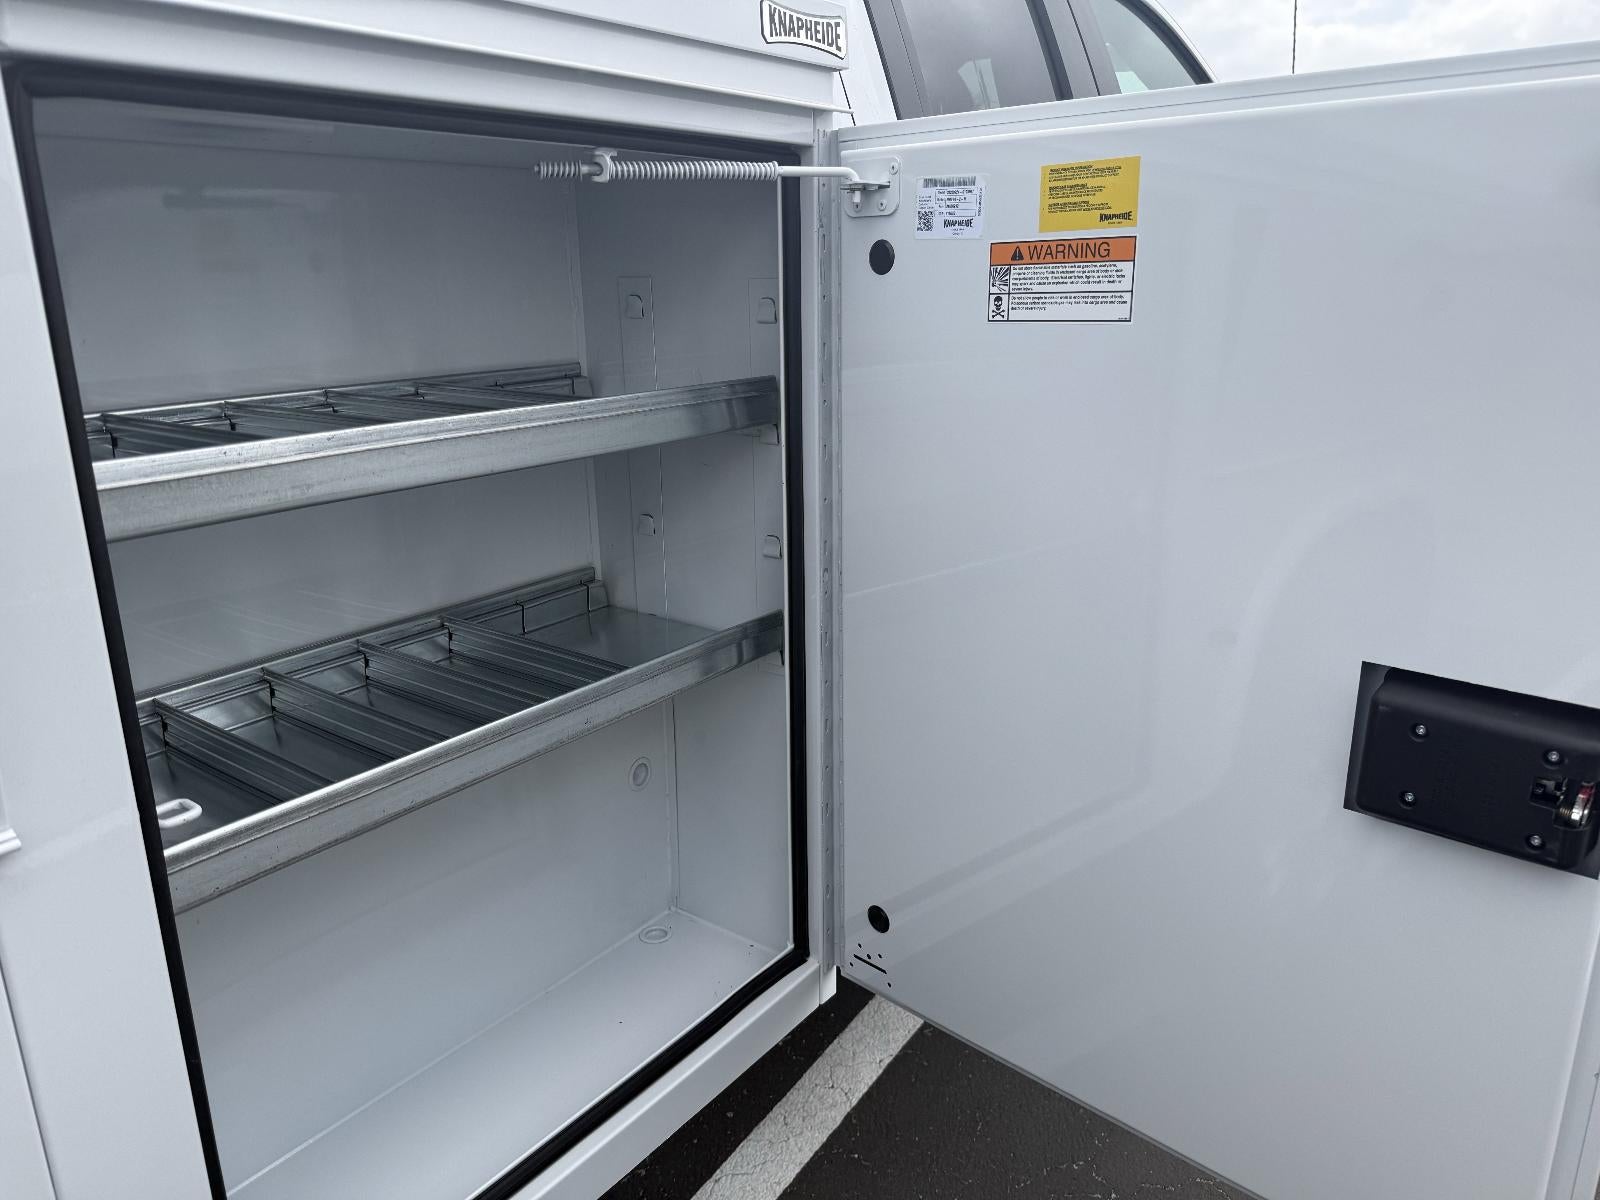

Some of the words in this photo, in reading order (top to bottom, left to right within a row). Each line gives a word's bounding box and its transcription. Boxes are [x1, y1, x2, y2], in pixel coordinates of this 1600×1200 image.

[768, 3, 842, 53] KNAPHEIDE
[1099, 211, 1133, 222] KNAPHEIDE
[1027, 241, 1111, 260] WARNING
